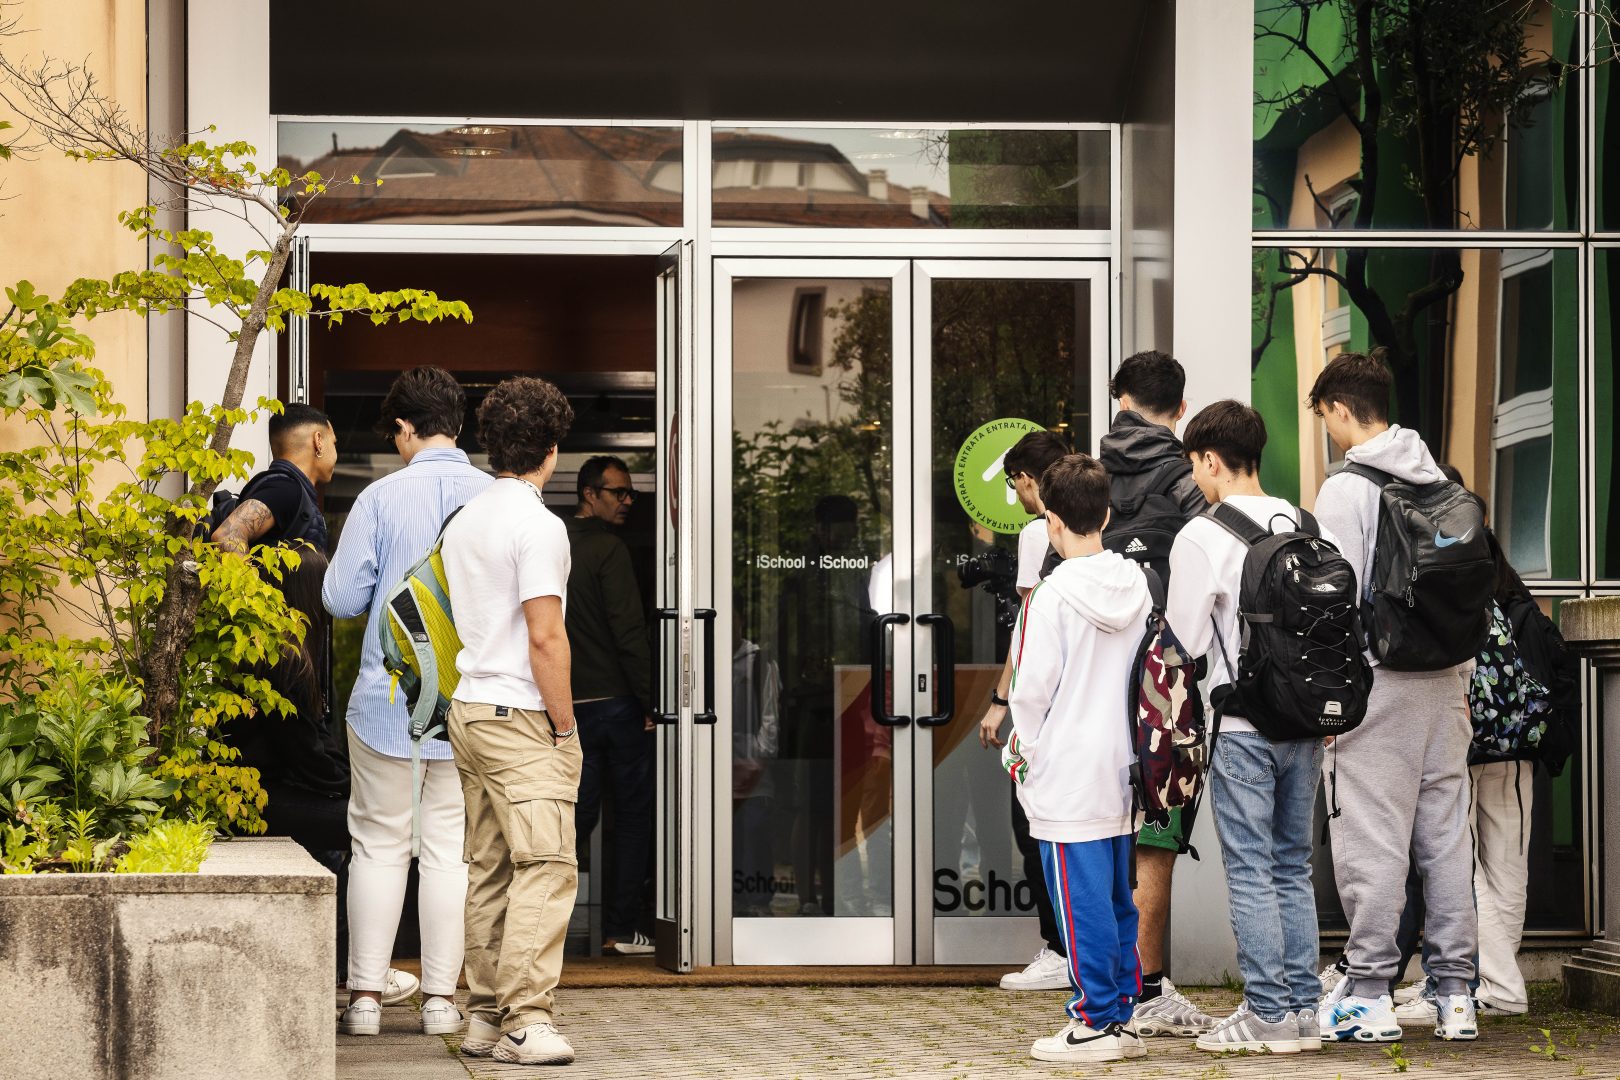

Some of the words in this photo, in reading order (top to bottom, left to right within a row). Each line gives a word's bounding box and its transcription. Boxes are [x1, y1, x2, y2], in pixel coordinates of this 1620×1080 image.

[986, 422, 1027, 433] ENTRATA
[959, 432, 985, 468] ENTRATA
[958, 471, 976, 512] ENTRATA
[976, 511, 1015, 530] ENTRATA
[756, 555, 805, 569] iSchool
[819, 555, 869, 569] iSchool
[933, 868, 1037, 912] Scho
